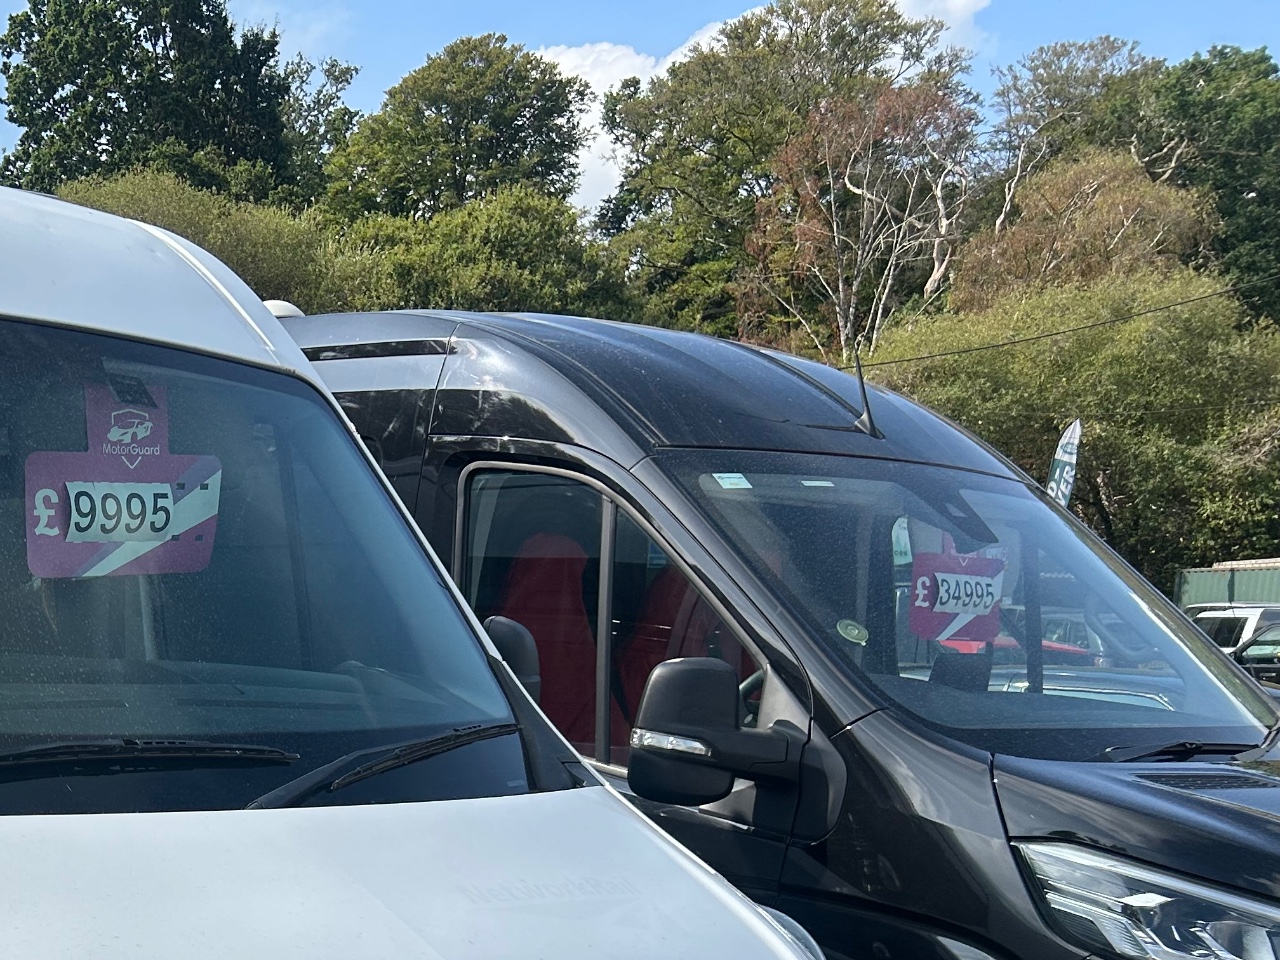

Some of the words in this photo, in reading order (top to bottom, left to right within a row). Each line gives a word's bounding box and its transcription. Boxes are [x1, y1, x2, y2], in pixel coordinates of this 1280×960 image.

[102, 443, 160, 455] MotorGuard
[73, 490, 171, 534] 9995
[939, 578, 995, 609] 34995
